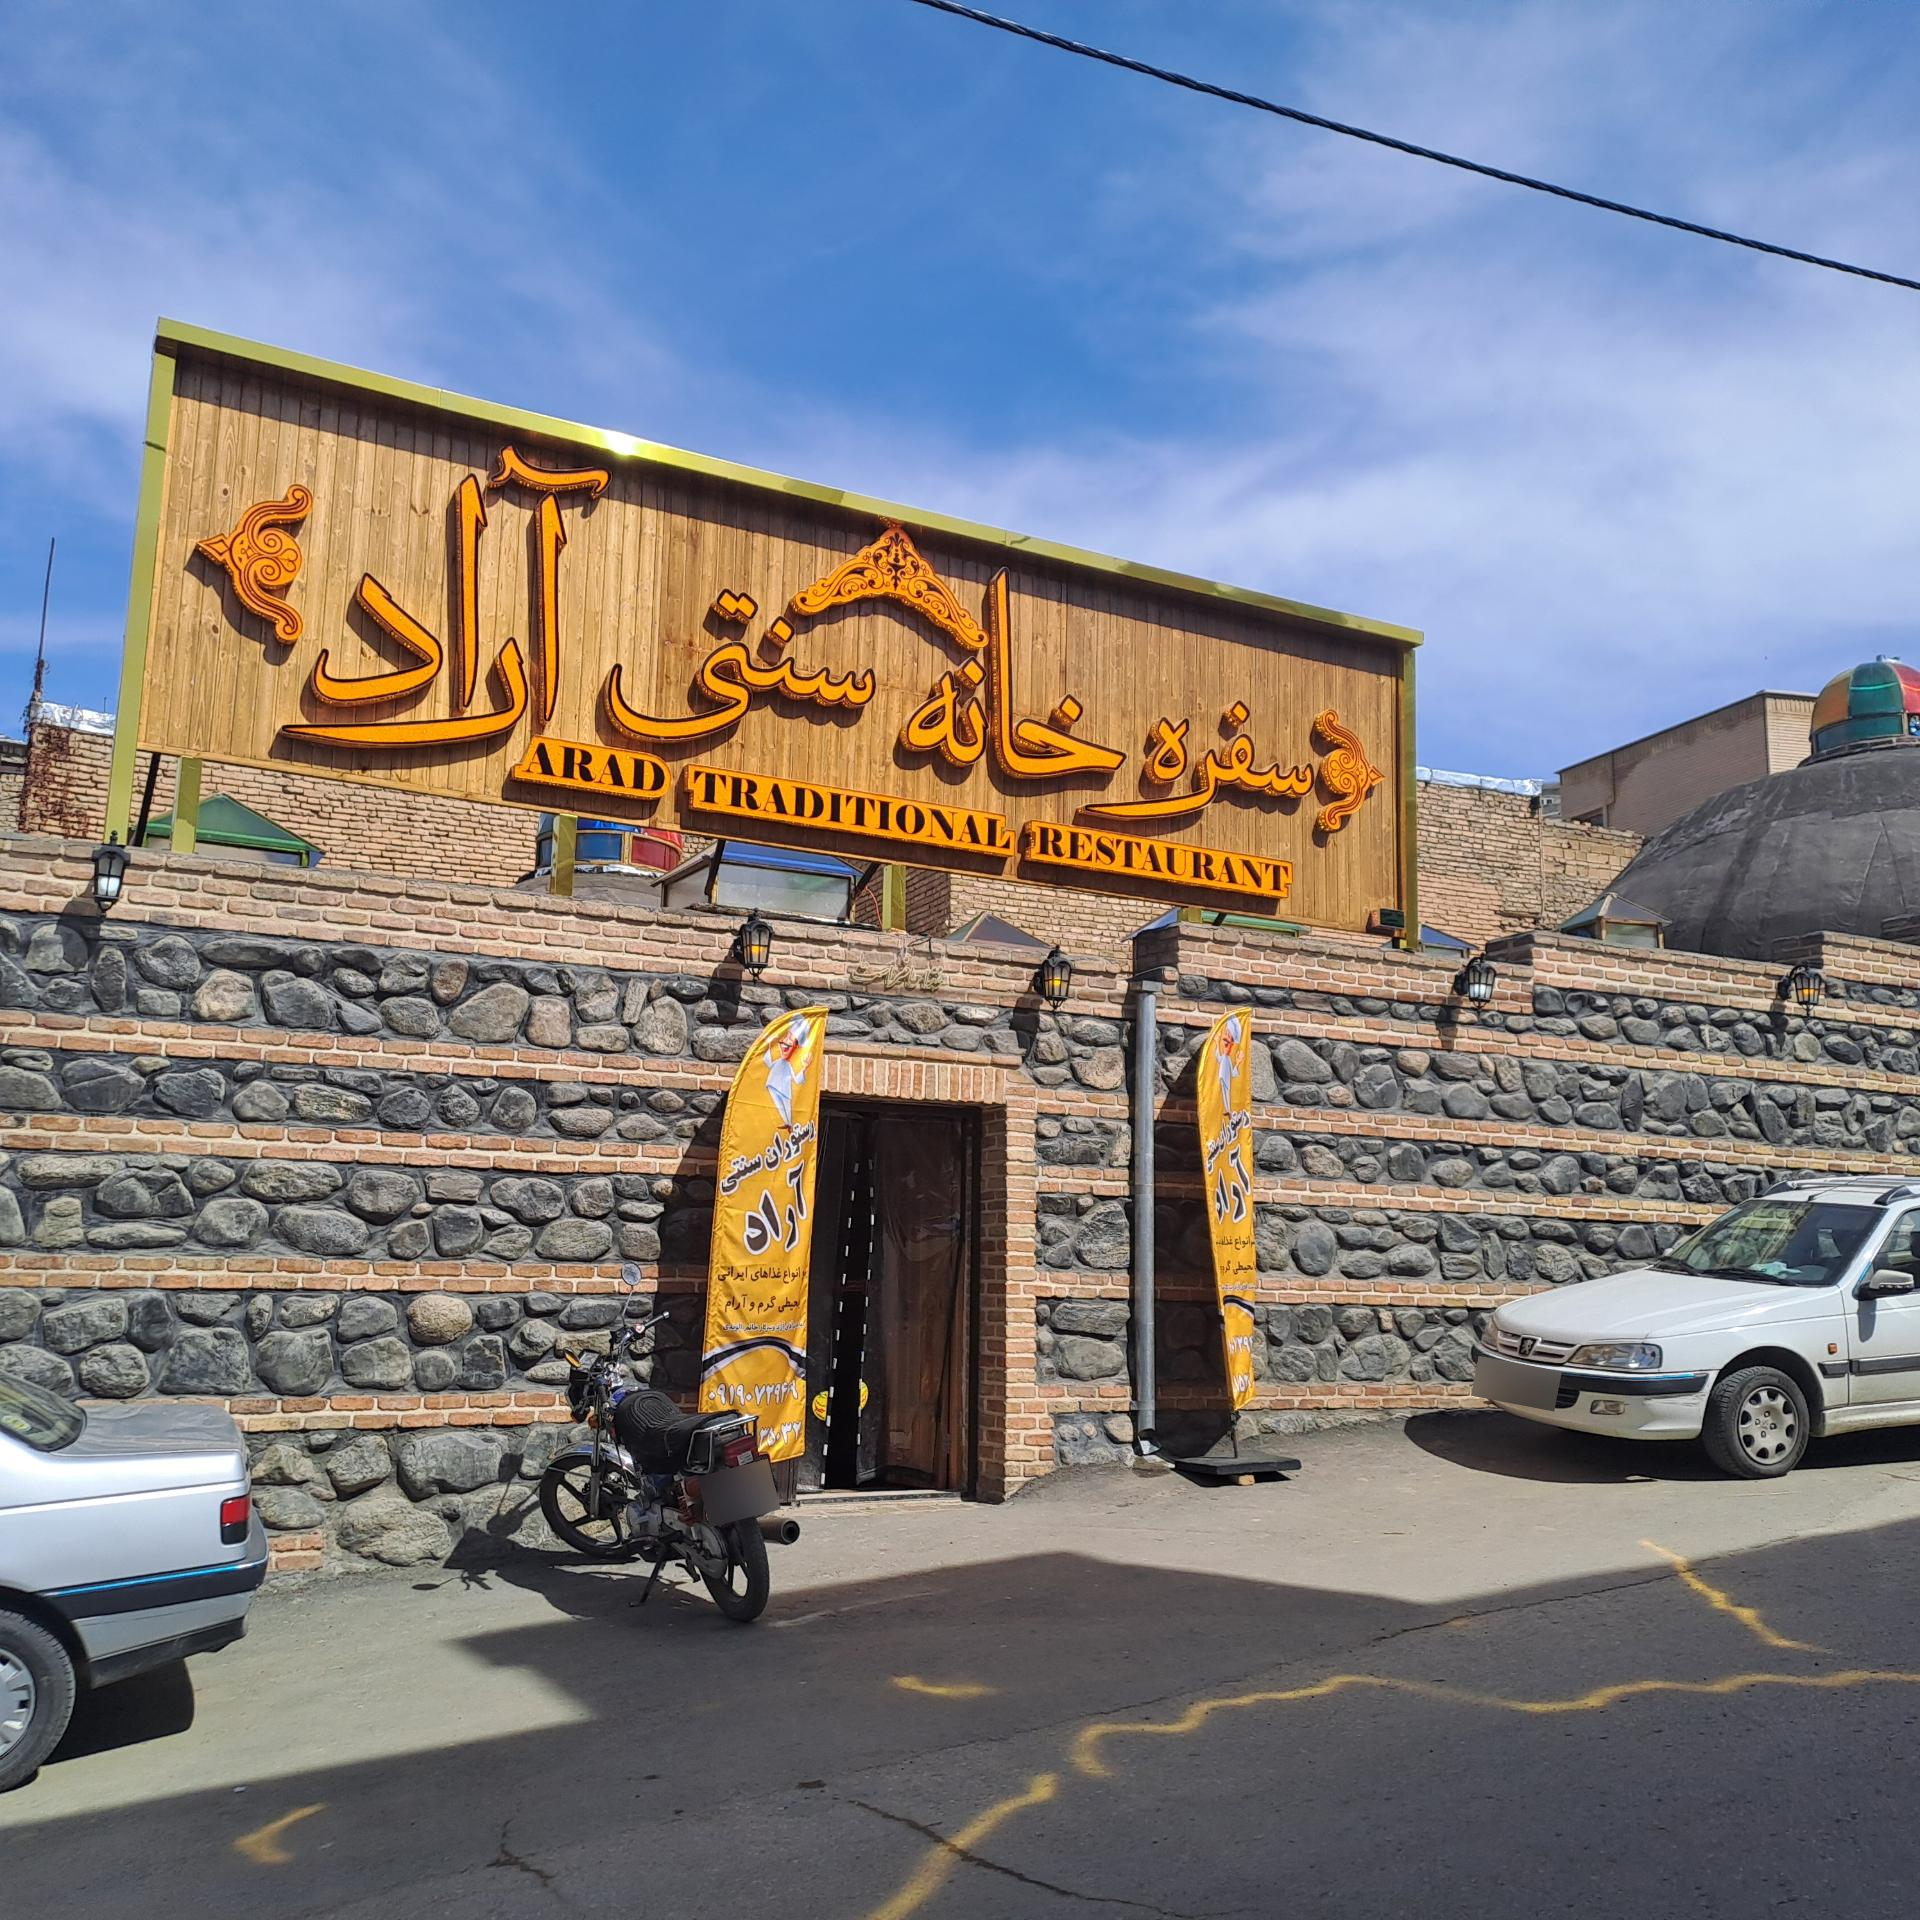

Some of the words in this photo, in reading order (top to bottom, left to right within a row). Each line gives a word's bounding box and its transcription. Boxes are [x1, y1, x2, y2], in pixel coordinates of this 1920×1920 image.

[280, 445, 612, 748] آراد
[605, 588, 876, 743] سنتی
[903, 567, 1127, 779] خانه
[1084, 700, 1314, 818] سفره
[526, 741, 665, 791] ARAD
[693, 771, 1012, 851] TRADITIONAL
[1035, 826, 1289, 893] RESTAURANT
[764, 1120, 816, 1171] رستوران
[720, 1153, 762, 1195] سنتی
[744, 1160, 807, 1255] آراد
[717, 1266, 748, 1281] ایرانی
[750, 1266, 781, 1281] غذاهای
[783, 1267, 800, 1284] انواع
[725, 1294, 747, 1312] آرام
[757, 1295, 776, 1314] گرم
